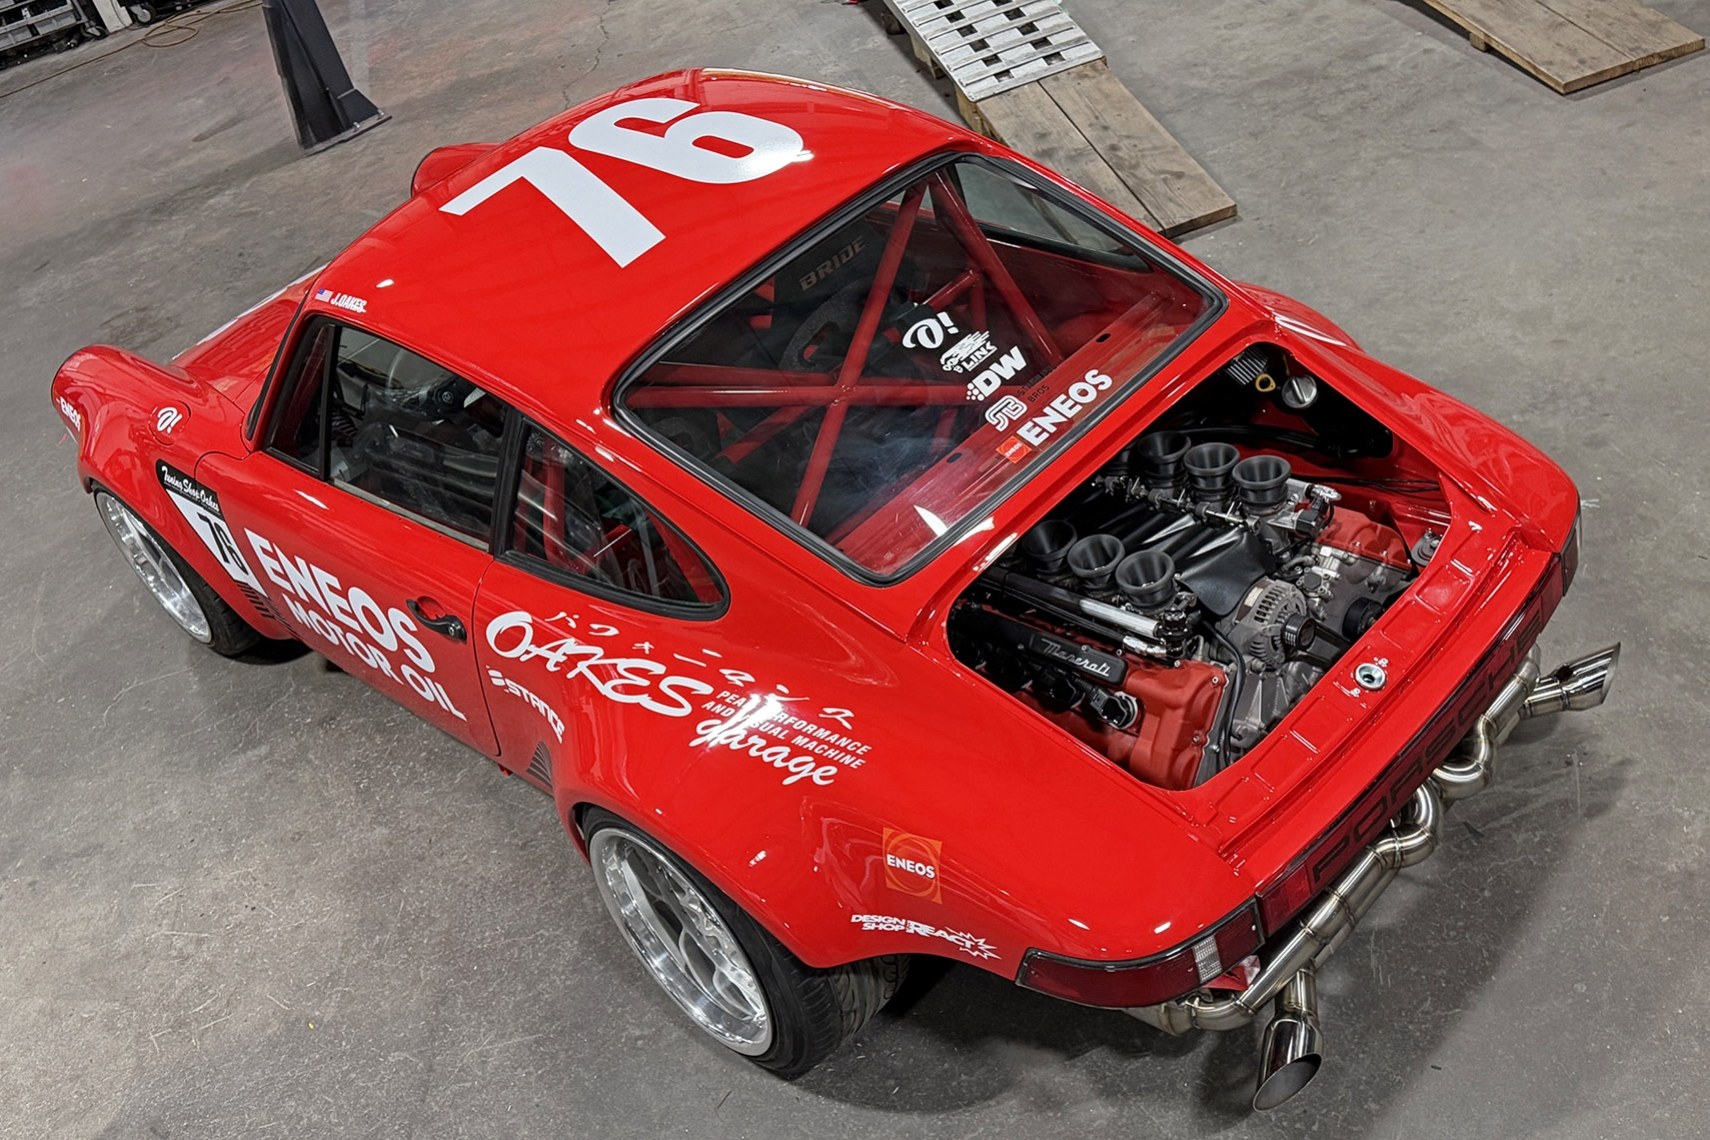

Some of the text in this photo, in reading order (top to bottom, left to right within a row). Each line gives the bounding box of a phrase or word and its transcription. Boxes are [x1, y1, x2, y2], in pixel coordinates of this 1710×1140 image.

[438, 98, 806, 269] 76
[799, 236, 866, 291] BRIDE
[971, 346, 1028, 397] DW
[1016, 369, 1113, 447] ENEOS
[196, 511, 249, 576] 76
[244, 528, 436, 673] ENEOS
[281, 592, 468, 722] MOTOR OIL
[486, 611, 714, 717] OAKES
[701, 700, 736, 719] AND
[790, 735, 866, 769] MACHINE
[1311, 610, 1541, 883] PORSCHE
[886, 853, 936, 880] ENEOS
[850, 914, 907, 926] DESIGN
[861, 922, 906, 932] SHOP
[905, 919, 977, 950] REACT
